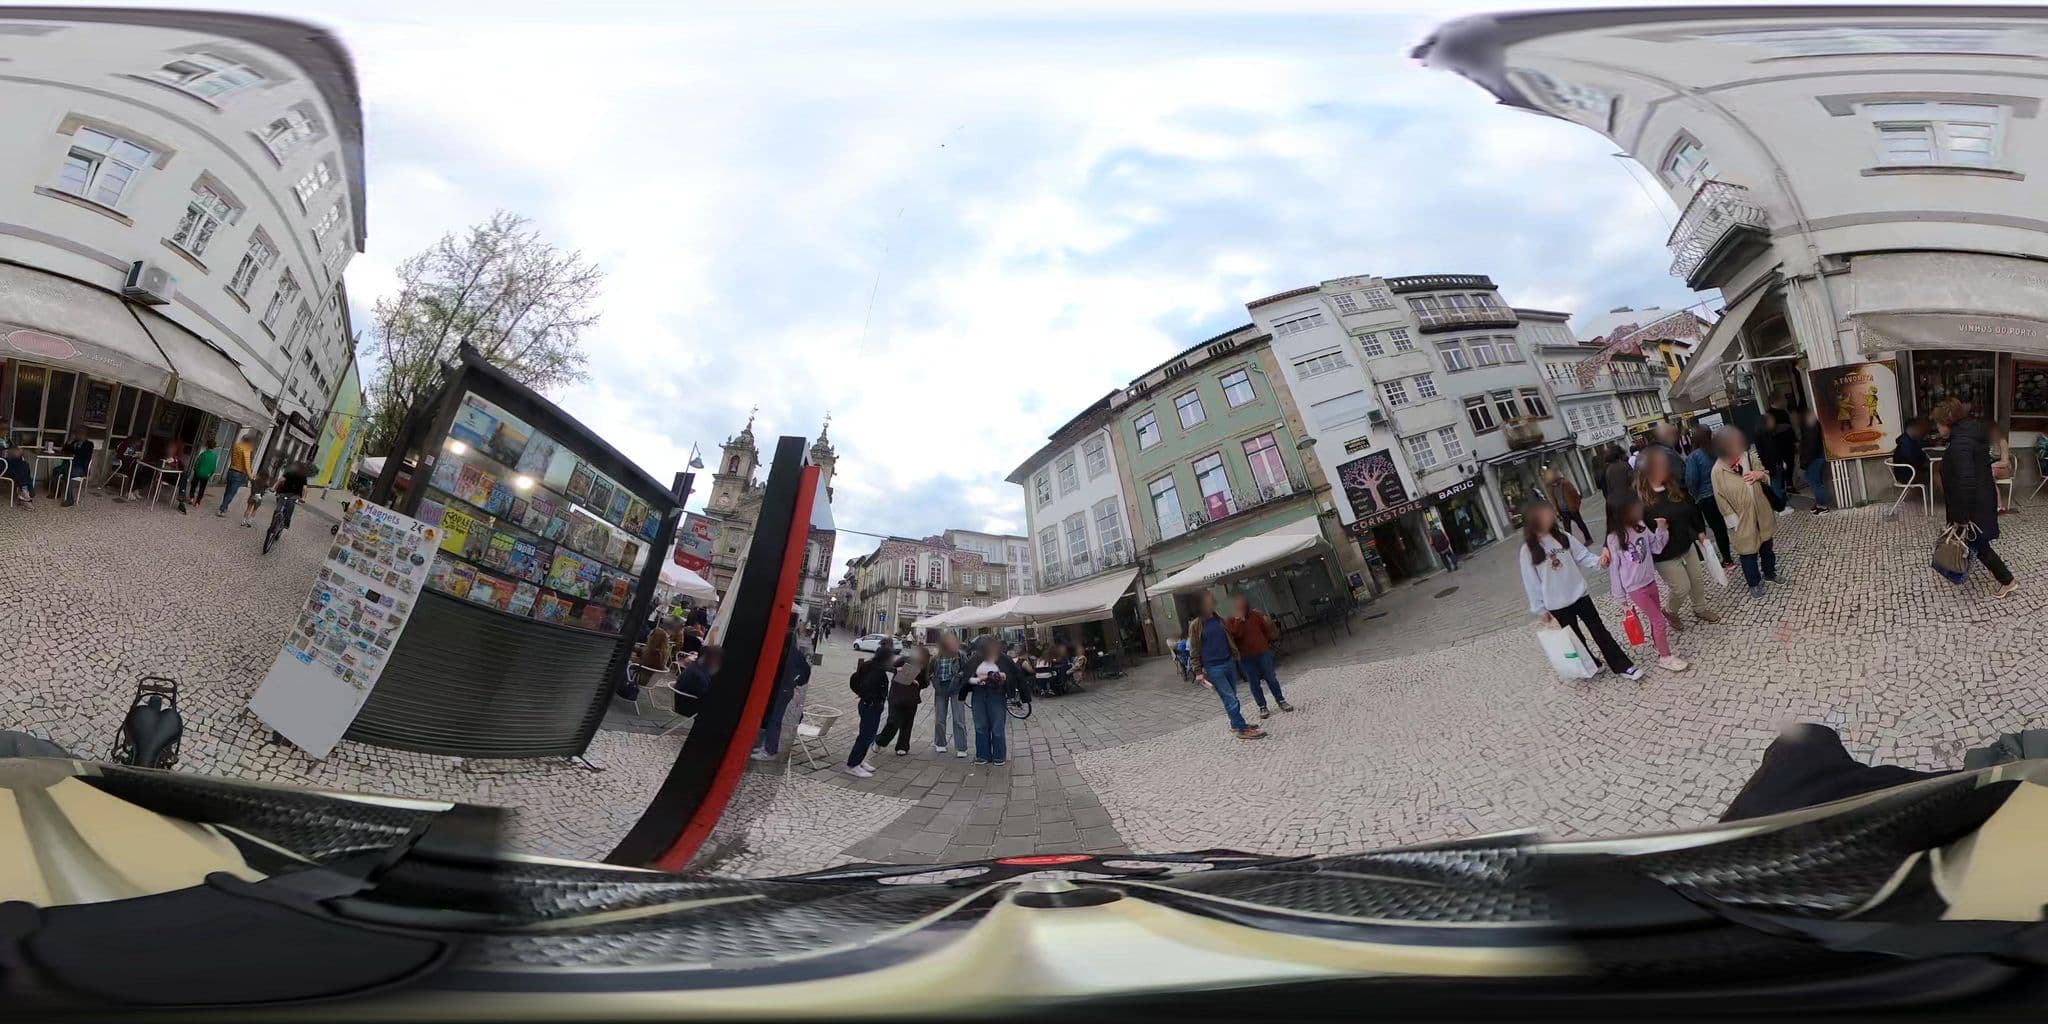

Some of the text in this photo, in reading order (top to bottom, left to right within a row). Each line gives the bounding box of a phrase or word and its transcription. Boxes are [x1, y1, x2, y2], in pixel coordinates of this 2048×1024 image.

[1959, 324, 1993, 334] VINHOS
[2009, 327, 2037, 337] PORTO
[1438, 480, 1474, 499] BARUC
[365, 503, 400, 525] Magnets
[1351, 501, 1422, 532] CORKSTORE
